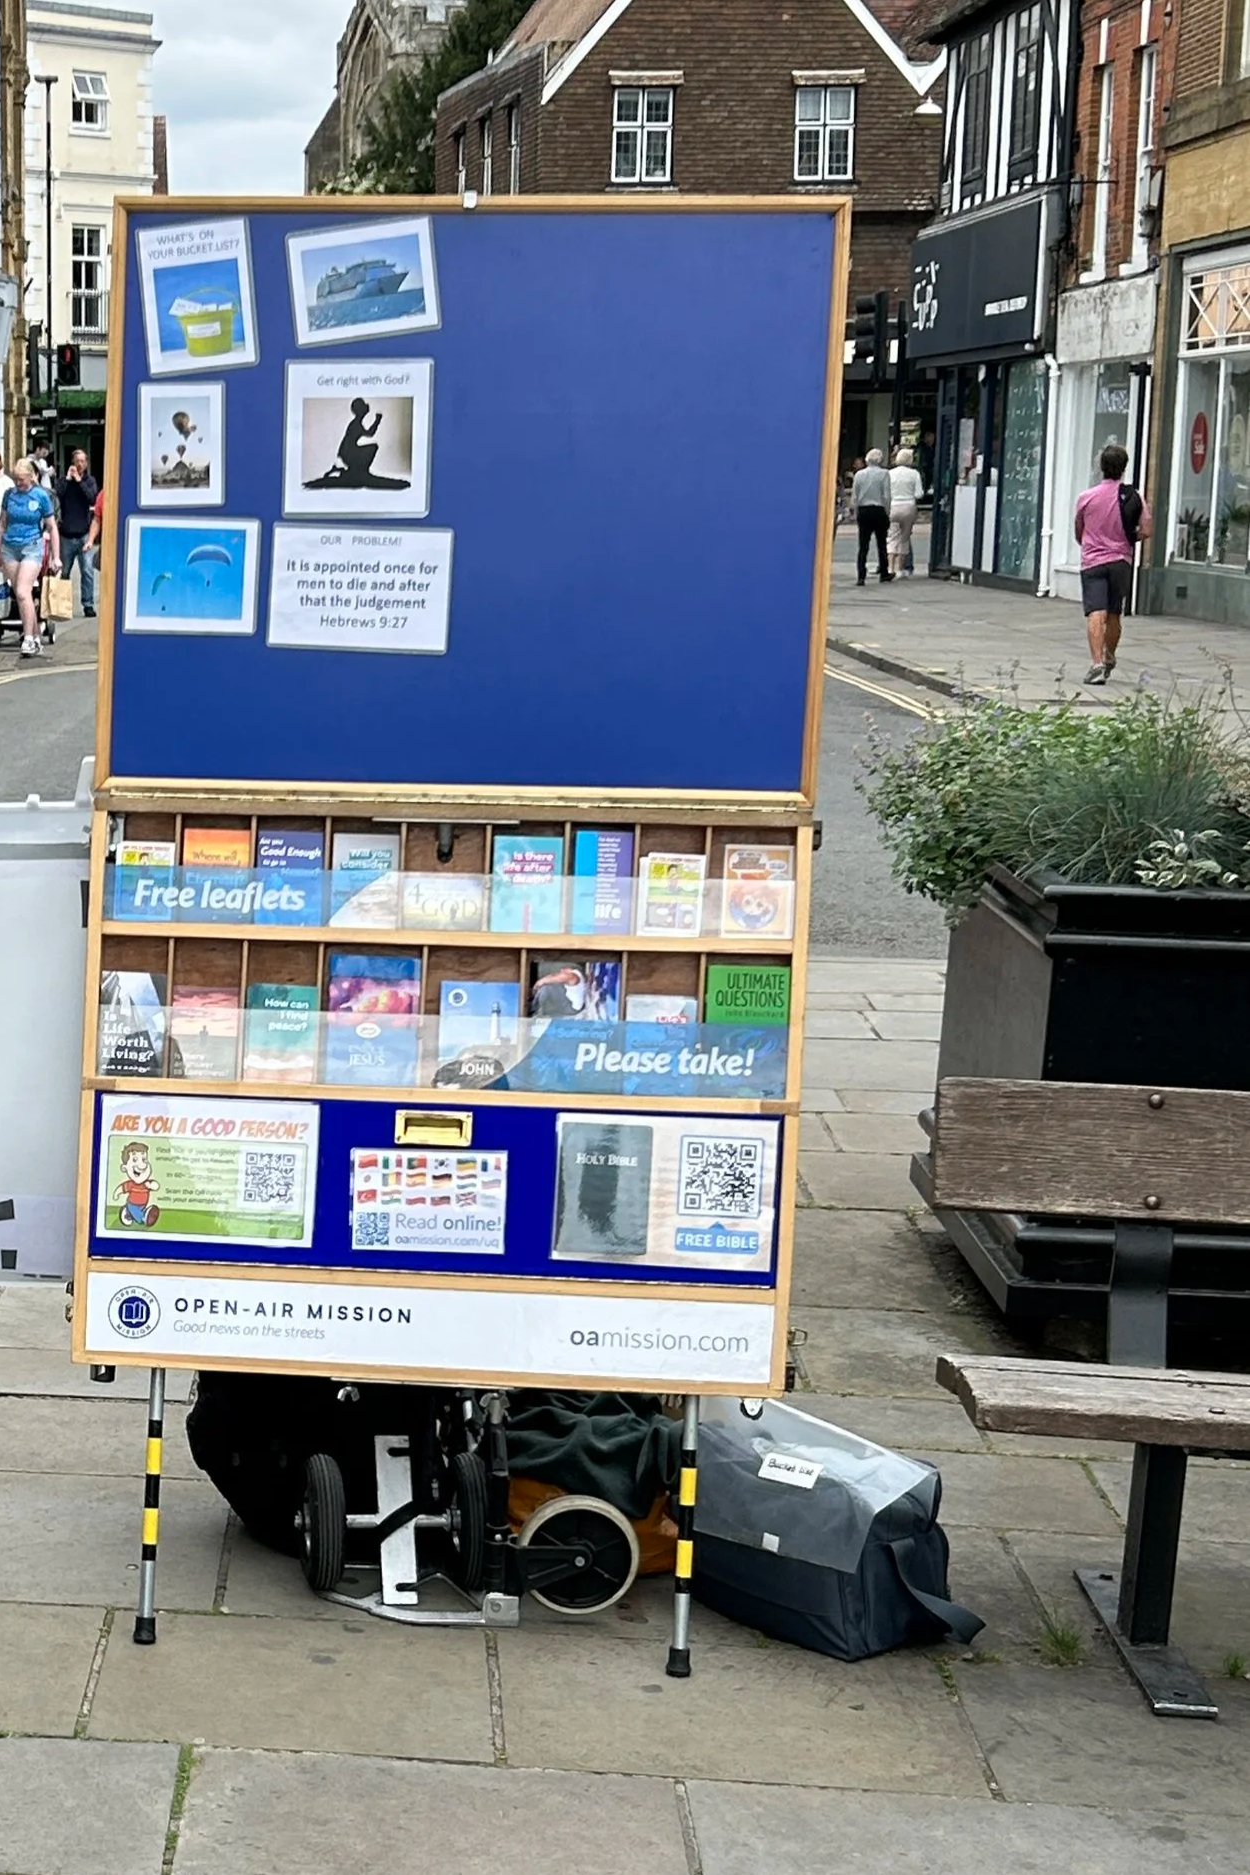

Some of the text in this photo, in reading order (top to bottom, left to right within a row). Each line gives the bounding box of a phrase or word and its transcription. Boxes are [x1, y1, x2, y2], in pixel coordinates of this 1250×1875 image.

[156, 230, 215, 246] WHAT'S ON
[148, 239, 240, 260] YOUR BUCKET LIST?
[317, 373, 411, 389] Get right with God?
[320, 535, 343, 546] OUR
[286, 559, 439, 575] It is appointed once for
[297, 578, 431, 592] men to die and after
[299, 595, 427, 611] that the judgement
[320, 615, 408, 629] Hebrews 9:27
[260, 847, 322, 860] Good Enough
[350, 849, 391, 860] Will you
[513, 850, 555, 862] Is there
[341, 860, 390, 870] consider
[523, 863, 553, 873] after
[134, 879, 306, 914] Free leaflets
[727, 972, 785, 991] ULTIMATE
[264, 998, 310, 1010] How can
[715, 990, 785, 1009] QUESTIONS
[103, 1010, 118, 1022] Is
[287, 1009, 309, 1021] find
[103, 1023, 131, 1035] Life
[268, 1021, 309, 1032] peace?
[102, 1035, 150, 1049] Worth
[102, 1048, 156, 1062] Living?
[348, 1053, 386, 1067] JESUS
[574, 1042, 755, 1077] Please take!
[459, 1062, 496, 1076] JOHN
[110, 1115, 310, 1140] ARE YOU A GOOD PERSON?
[575, 1152, 639, 1167] HOLY BIBLE
[395, 1214, 502, 1231] Read online!
[395, 1234, 500, 1249] oamission.com/uq
[676, 1232, 759, 1249] FREE BIBLE
[175, 1297, 413, 1324] OPEN-AIR MISSION
[173, 1319, 326, 1340] Good news on the streets
[569, 1326, 749, 1353] oamission.com
